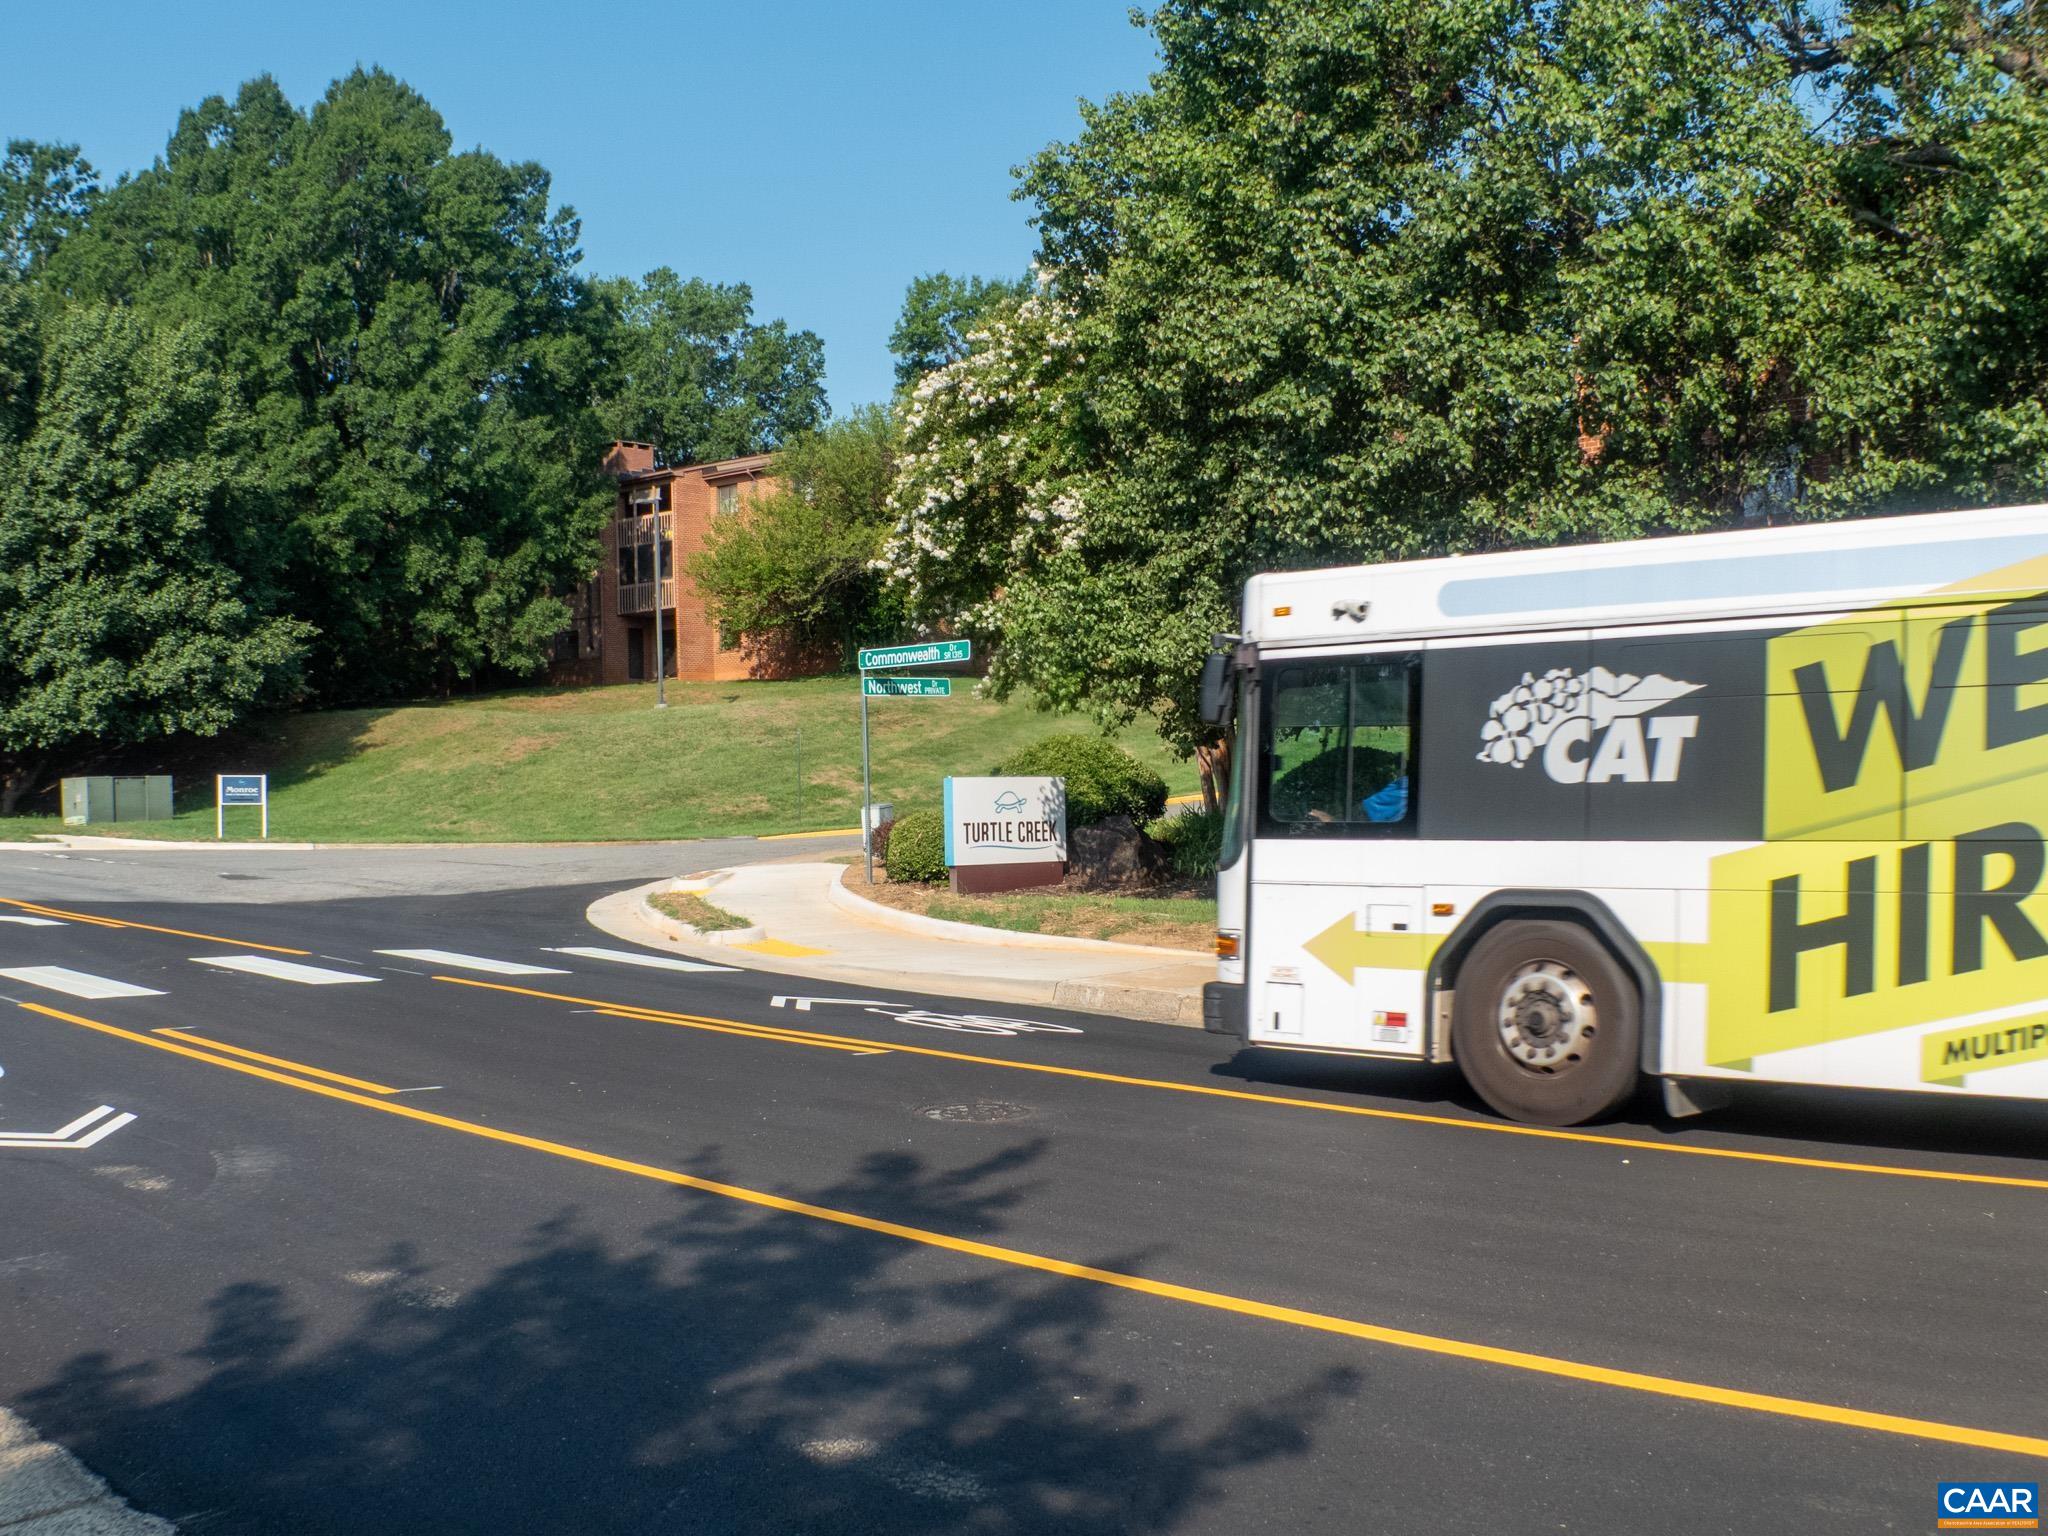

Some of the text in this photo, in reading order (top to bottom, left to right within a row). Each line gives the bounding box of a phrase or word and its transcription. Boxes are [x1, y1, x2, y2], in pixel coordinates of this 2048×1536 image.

[865, 643, 957, 666] Commonwealth Dr
[944, 652, 952, 660] SR
[868, 680, 922, 694] Northwest
[924, 687, 946, 695] PRIVATE
[1791, 590, 2048, 793] WE
[1543, 715, 1699, 784] CAT
[963, 820, 1058, 844] TURTLE CREEK
[1766, 821, 2048, 1014] HIR
